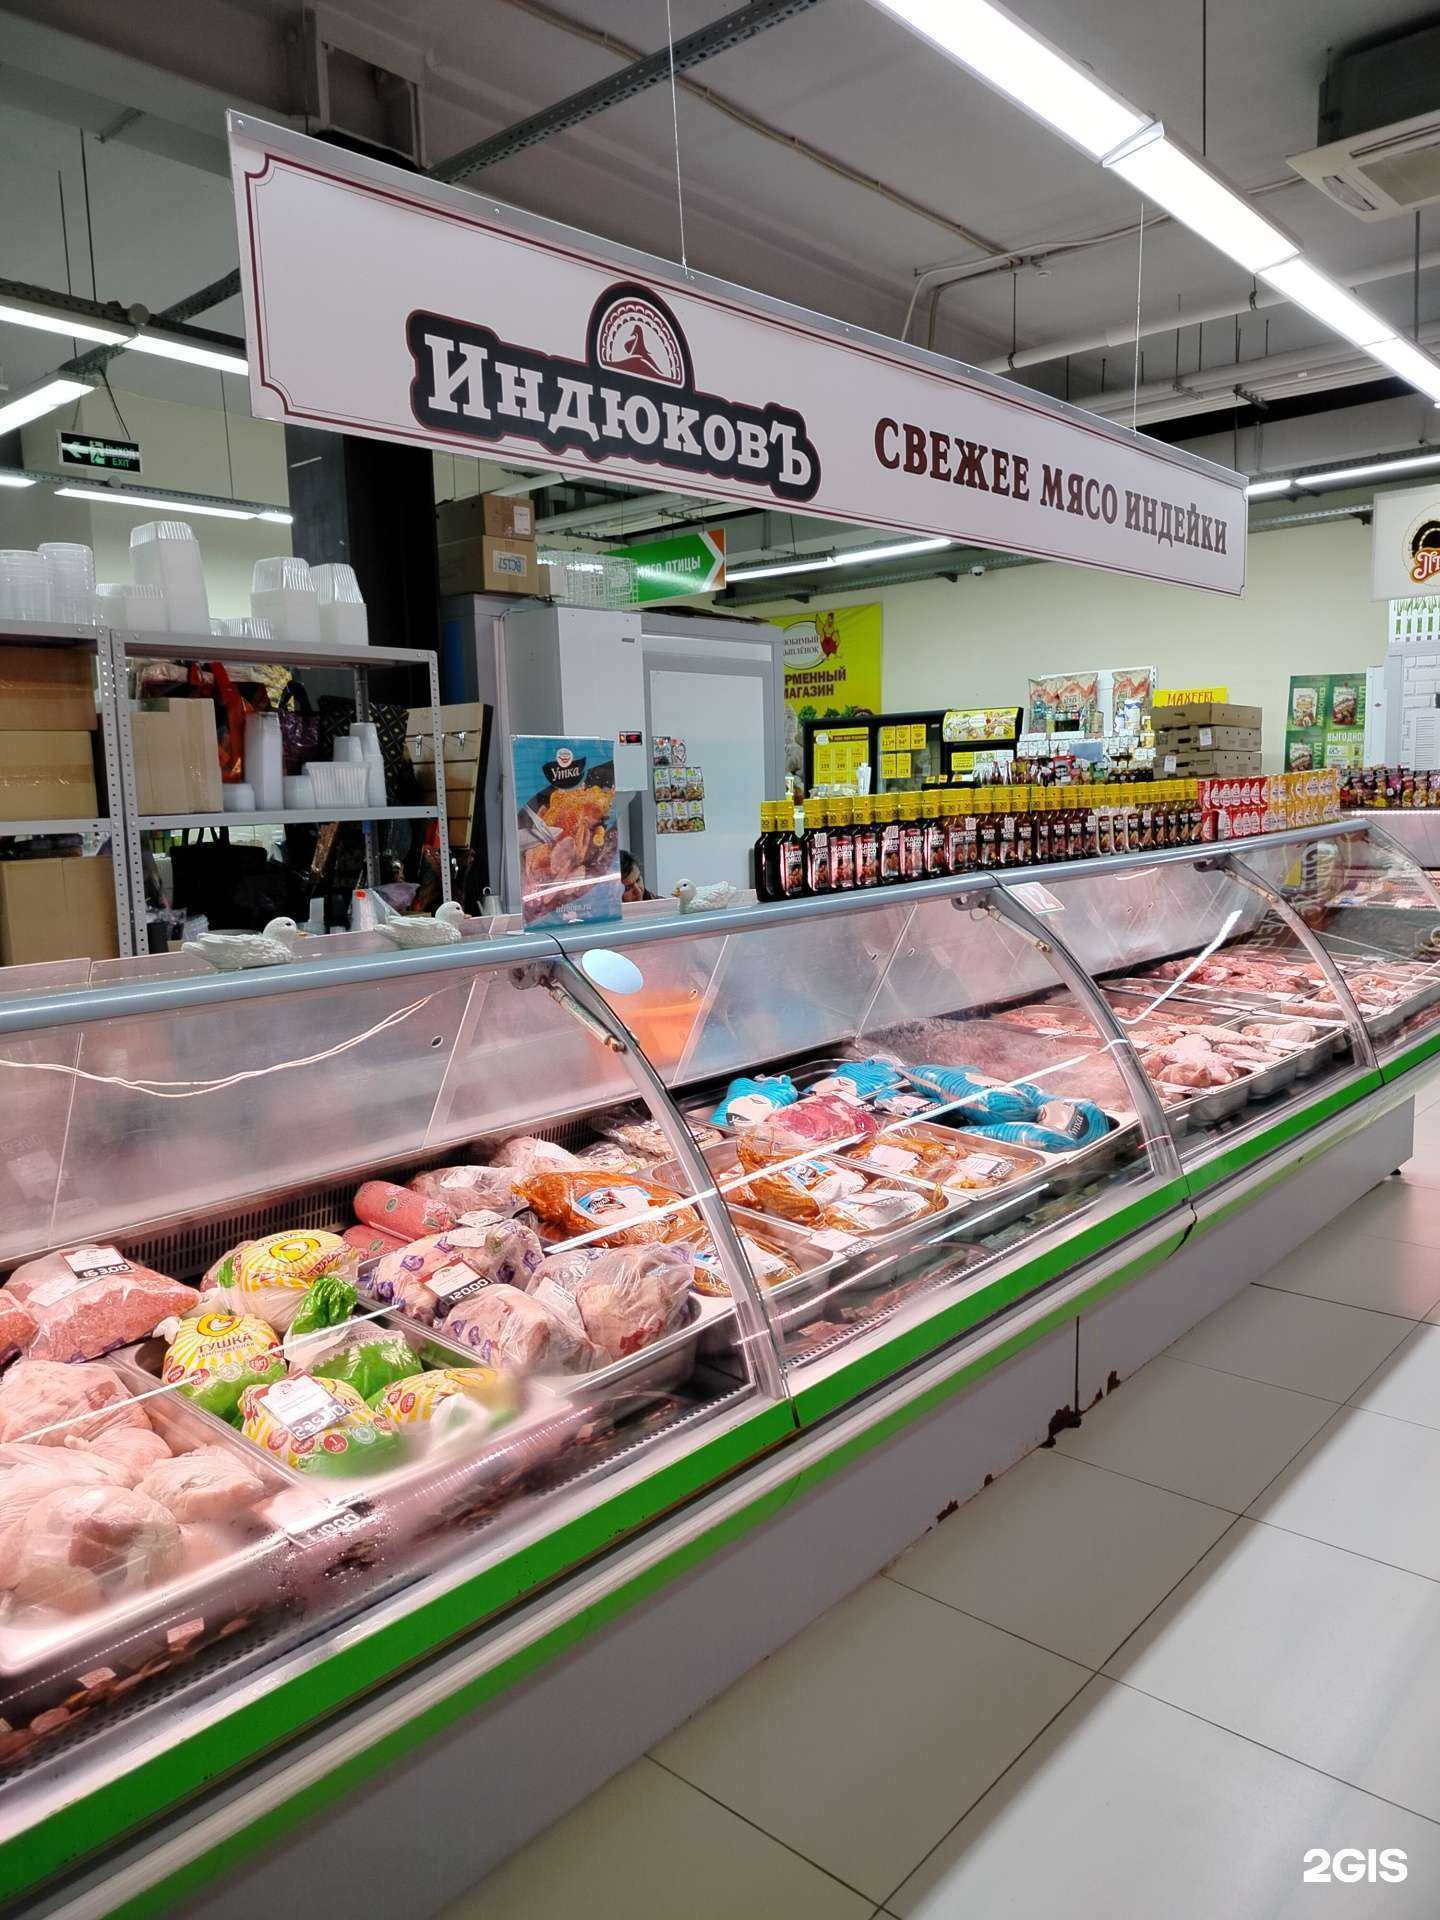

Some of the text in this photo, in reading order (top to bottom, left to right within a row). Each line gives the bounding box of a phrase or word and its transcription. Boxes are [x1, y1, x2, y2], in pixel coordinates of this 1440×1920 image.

[874, 417, 1228, 556] СВЕЖЕЕ МЯСО ИНДЕЙКИ
[665, 556, 701, 574] ПТИЦЫ
[784, 636, 819, 646] ЮБИМЫЙ
[784, 666, 847, 686] РМЕННЫЙ
[551, 767, 580, 781] Утка
[199, 1333, 252, 1353] ТУШКА
